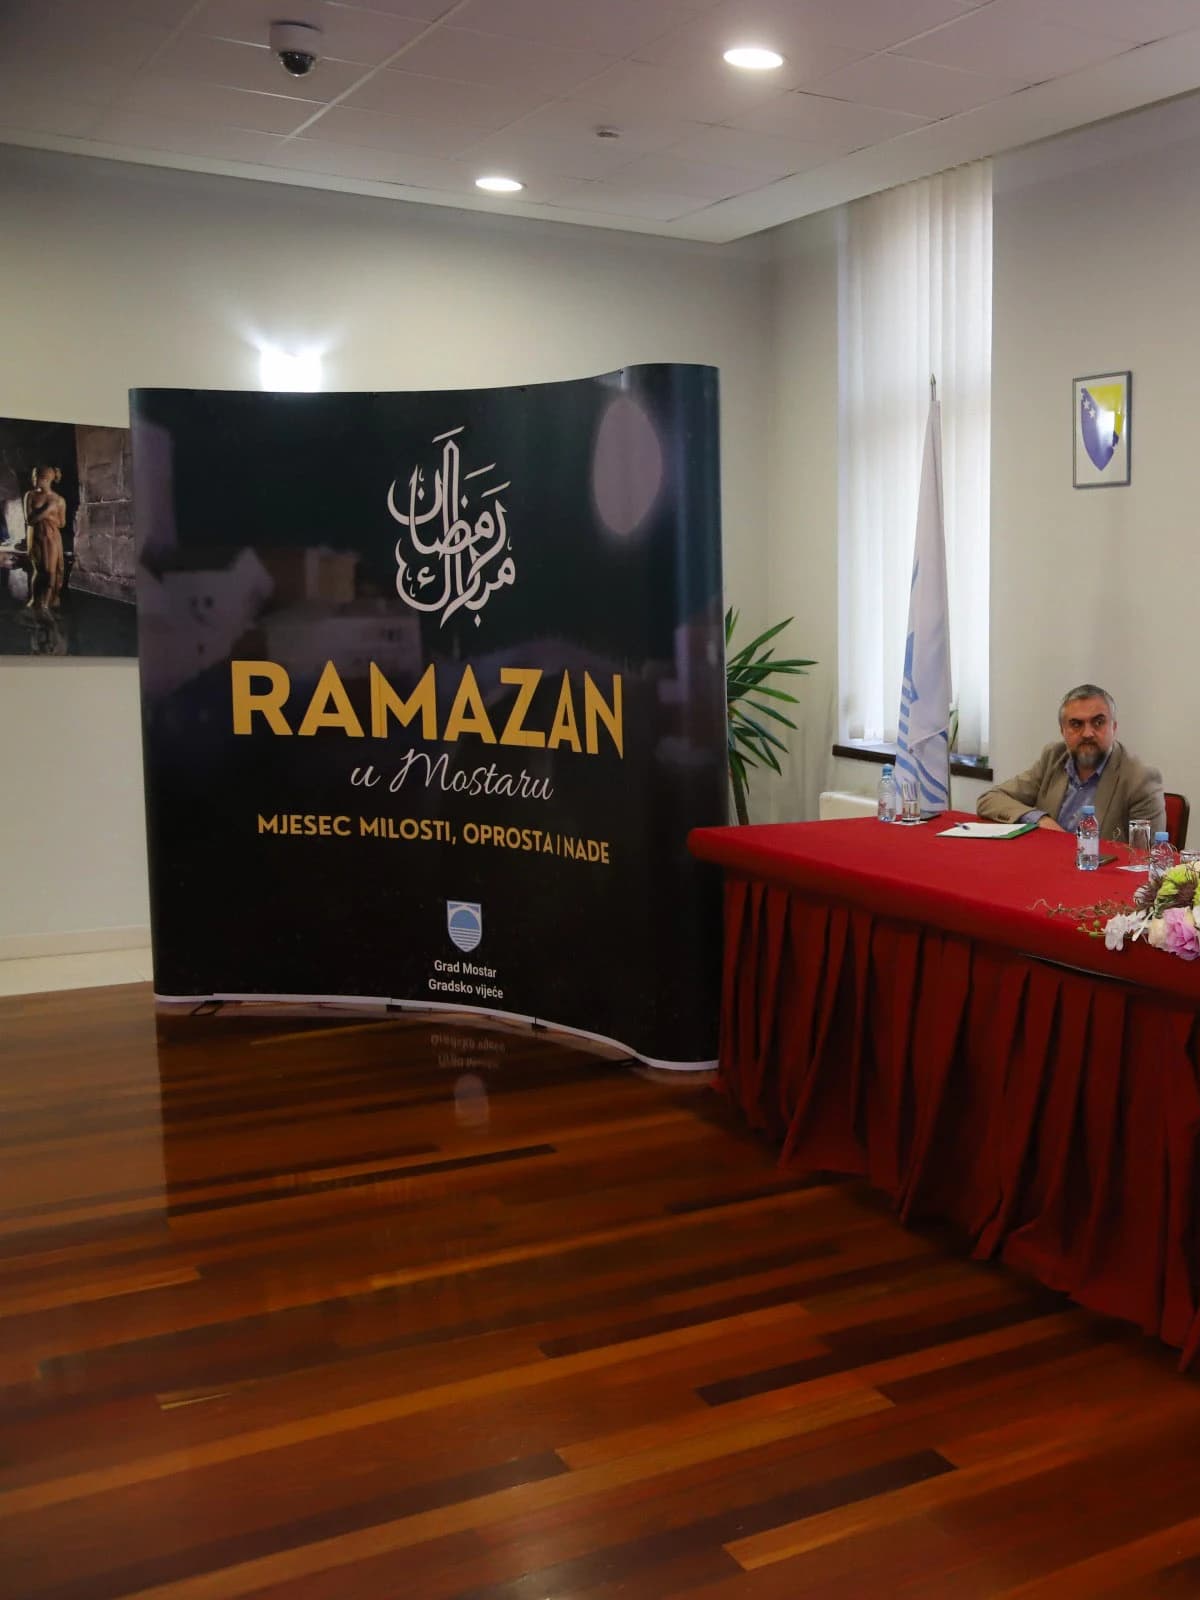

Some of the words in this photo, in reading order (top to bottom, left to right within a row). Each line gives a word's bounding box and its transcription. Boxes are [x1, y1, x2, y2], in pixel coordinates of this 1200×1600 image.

[230, 659, 624, 759] RAMAZAN
[350, 764, 381, 787] u
[389, 747, 554, 800] Mostaru
[257, 813, 352, 836] MJESEC
[359, 816, 457, 845] MILOSTI,
[462, 822, 553, 855] OPROSTA
[555, 834, 561, 856] I
[563, 836, 611, 864] NADE
[428, 978, 473, 994] Gradsko
[475, 984, 504, 999] vijeće
[433, 959, 460, 973] Grad
[462, 962, 498, 978] Mostar
